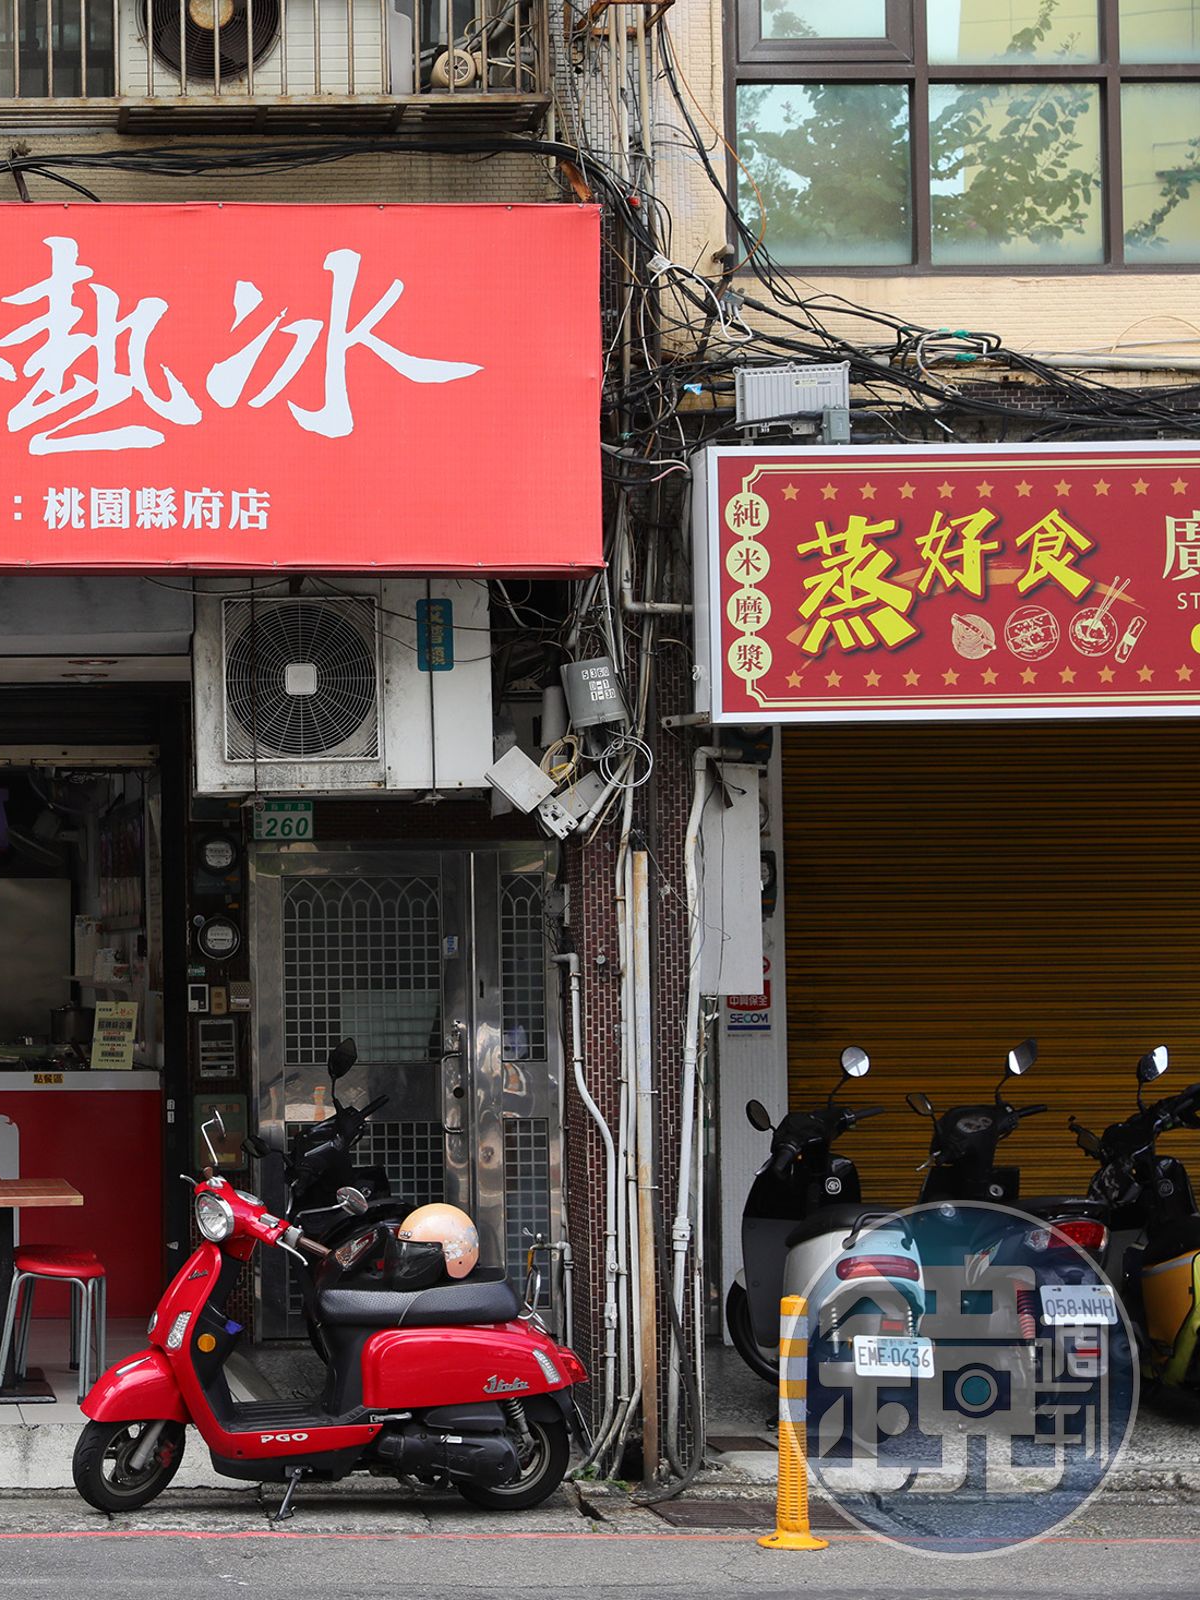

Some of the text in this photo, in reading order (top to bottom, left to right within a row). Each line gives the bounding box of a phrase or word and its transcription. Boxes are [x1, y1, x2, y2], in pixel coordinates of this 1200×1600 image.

[796, 508, 1093, 654] 蒸好食
[582, 667, 609, 680] 5360
[265, 817, 309, 837] 260
[730, 1013, 769, 1023] SECOM
[33, 1074, 64, 1084] 點餐區
[261, 1432, 309, 1444] PGO
